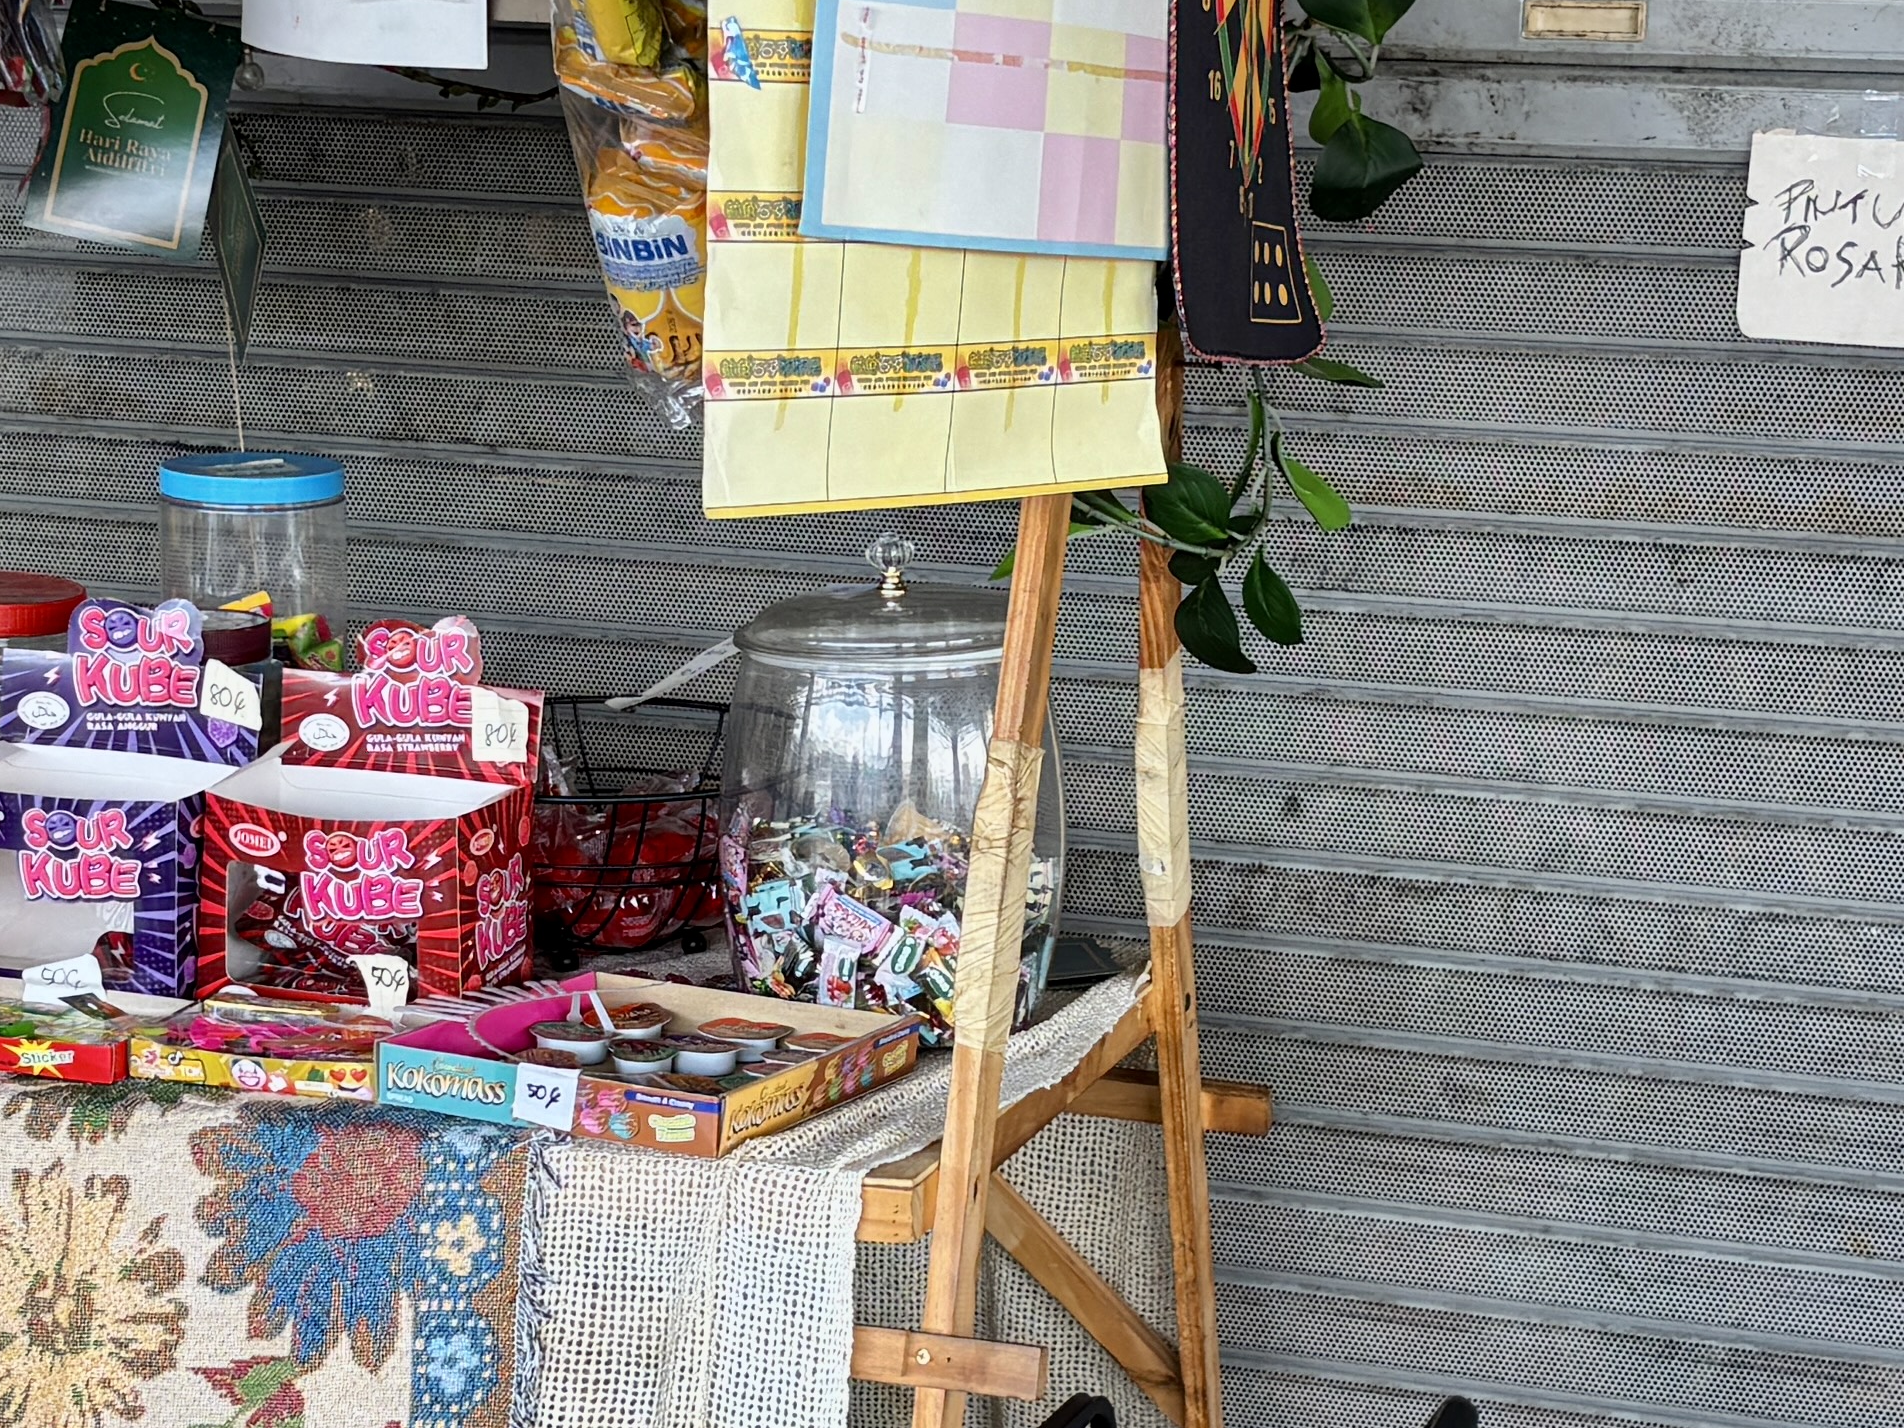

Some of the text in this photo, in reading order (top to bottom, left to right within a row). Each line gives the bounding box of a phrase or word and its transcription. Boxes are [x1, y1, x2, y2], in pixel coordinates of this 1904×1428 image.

[1208, 68, 1222, 101] 16
[79, 128, 173, 164] Hari Raya
[75, 653, 200, 707] KUBE
[353, 674, 473, 728] KUBE
[86, 722, 115, 731] RASA
[366, 743, 394, 753] RASA
[19, 850, 142, 899] KUBE
[300, 871, 424, 921] KUBE
[20, 1050, 74, 1066] Sticker
